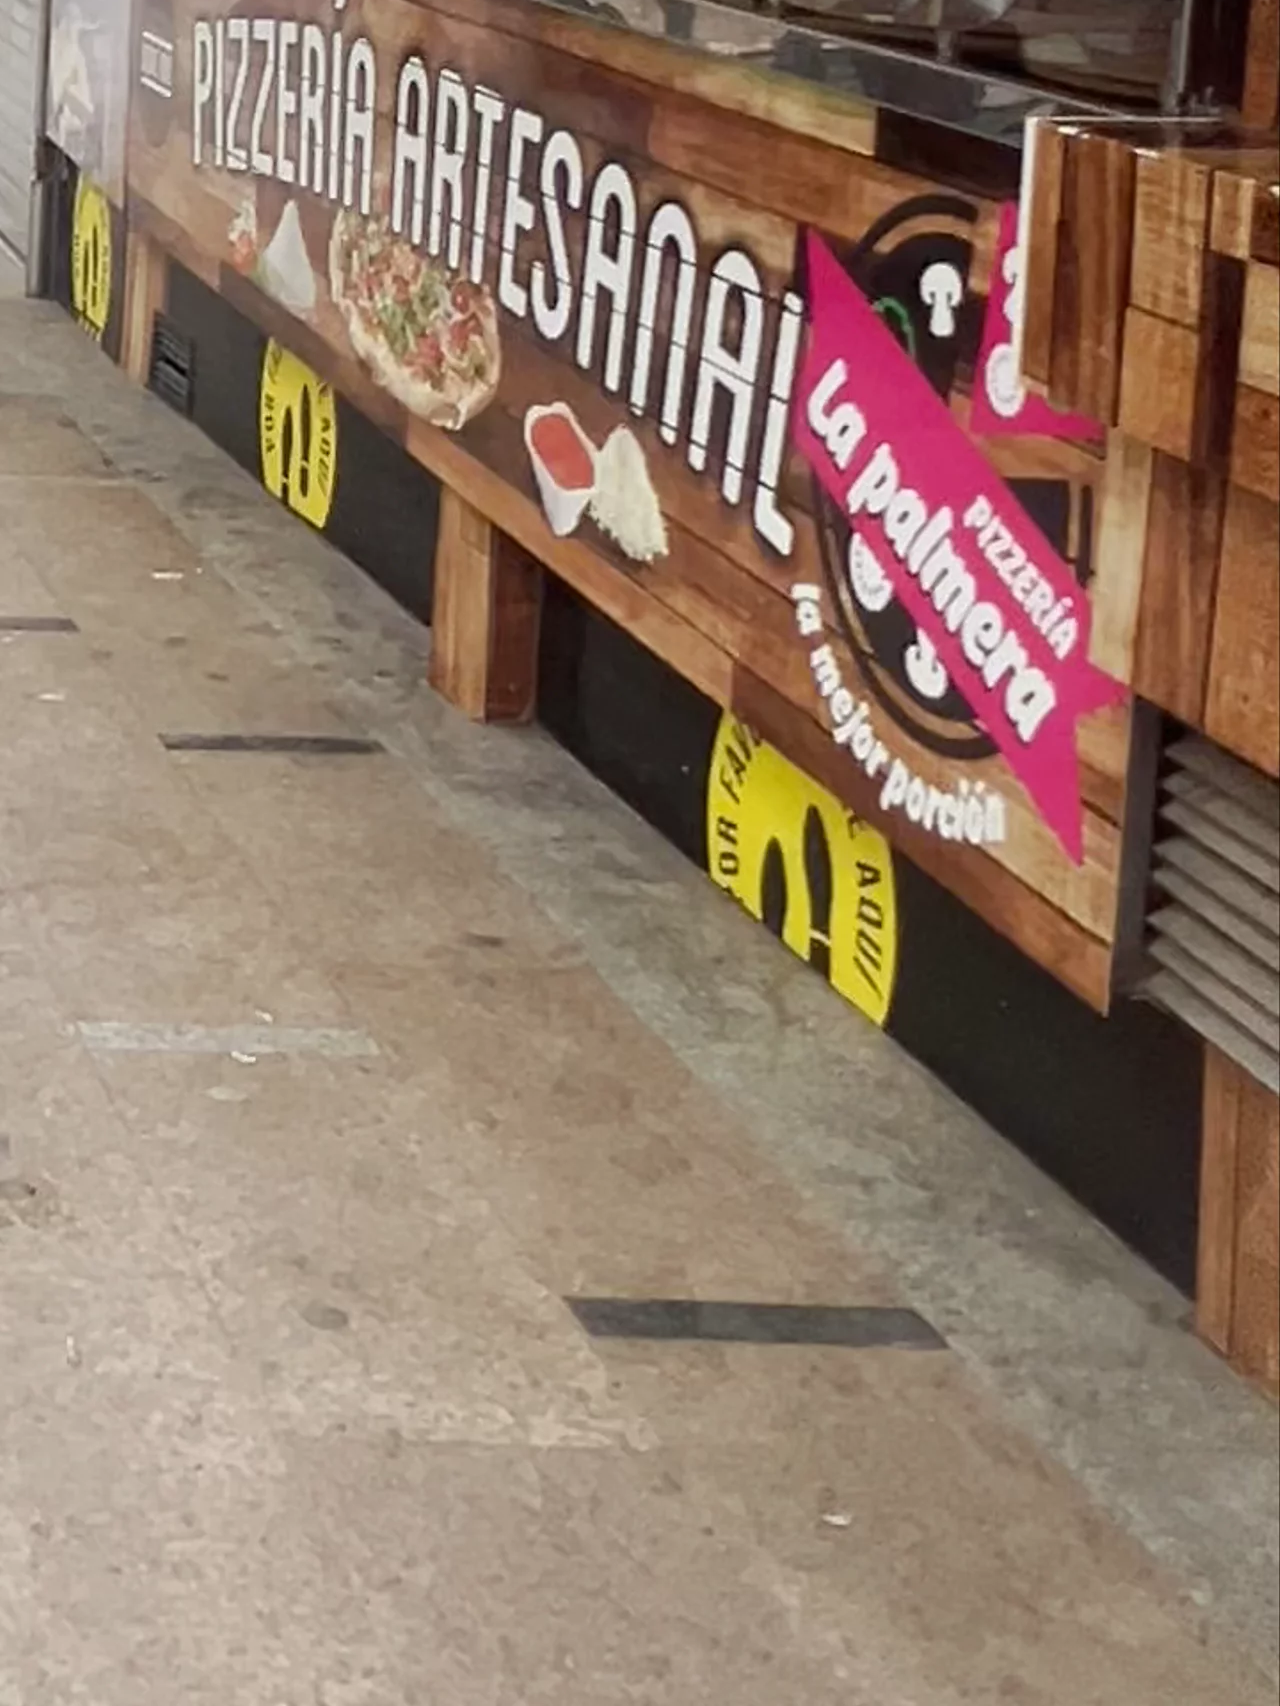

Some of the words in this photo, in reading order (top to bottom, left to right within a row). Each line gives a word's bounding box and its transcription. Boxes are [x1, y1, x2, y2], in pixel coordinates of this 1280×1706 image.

[391, 56, 804, 557] ARTESANAL
[807, 358, 868, 470] La
[846, 442, 1057, 744] palmera
[963, 494, 1079, 661] PIZZERÍA
[792, 583, 823, 635] la
[810, 643, 889, 778] mejor
[879, 758, 1009, 844] porción
[716, 816, 745, 908] OR
